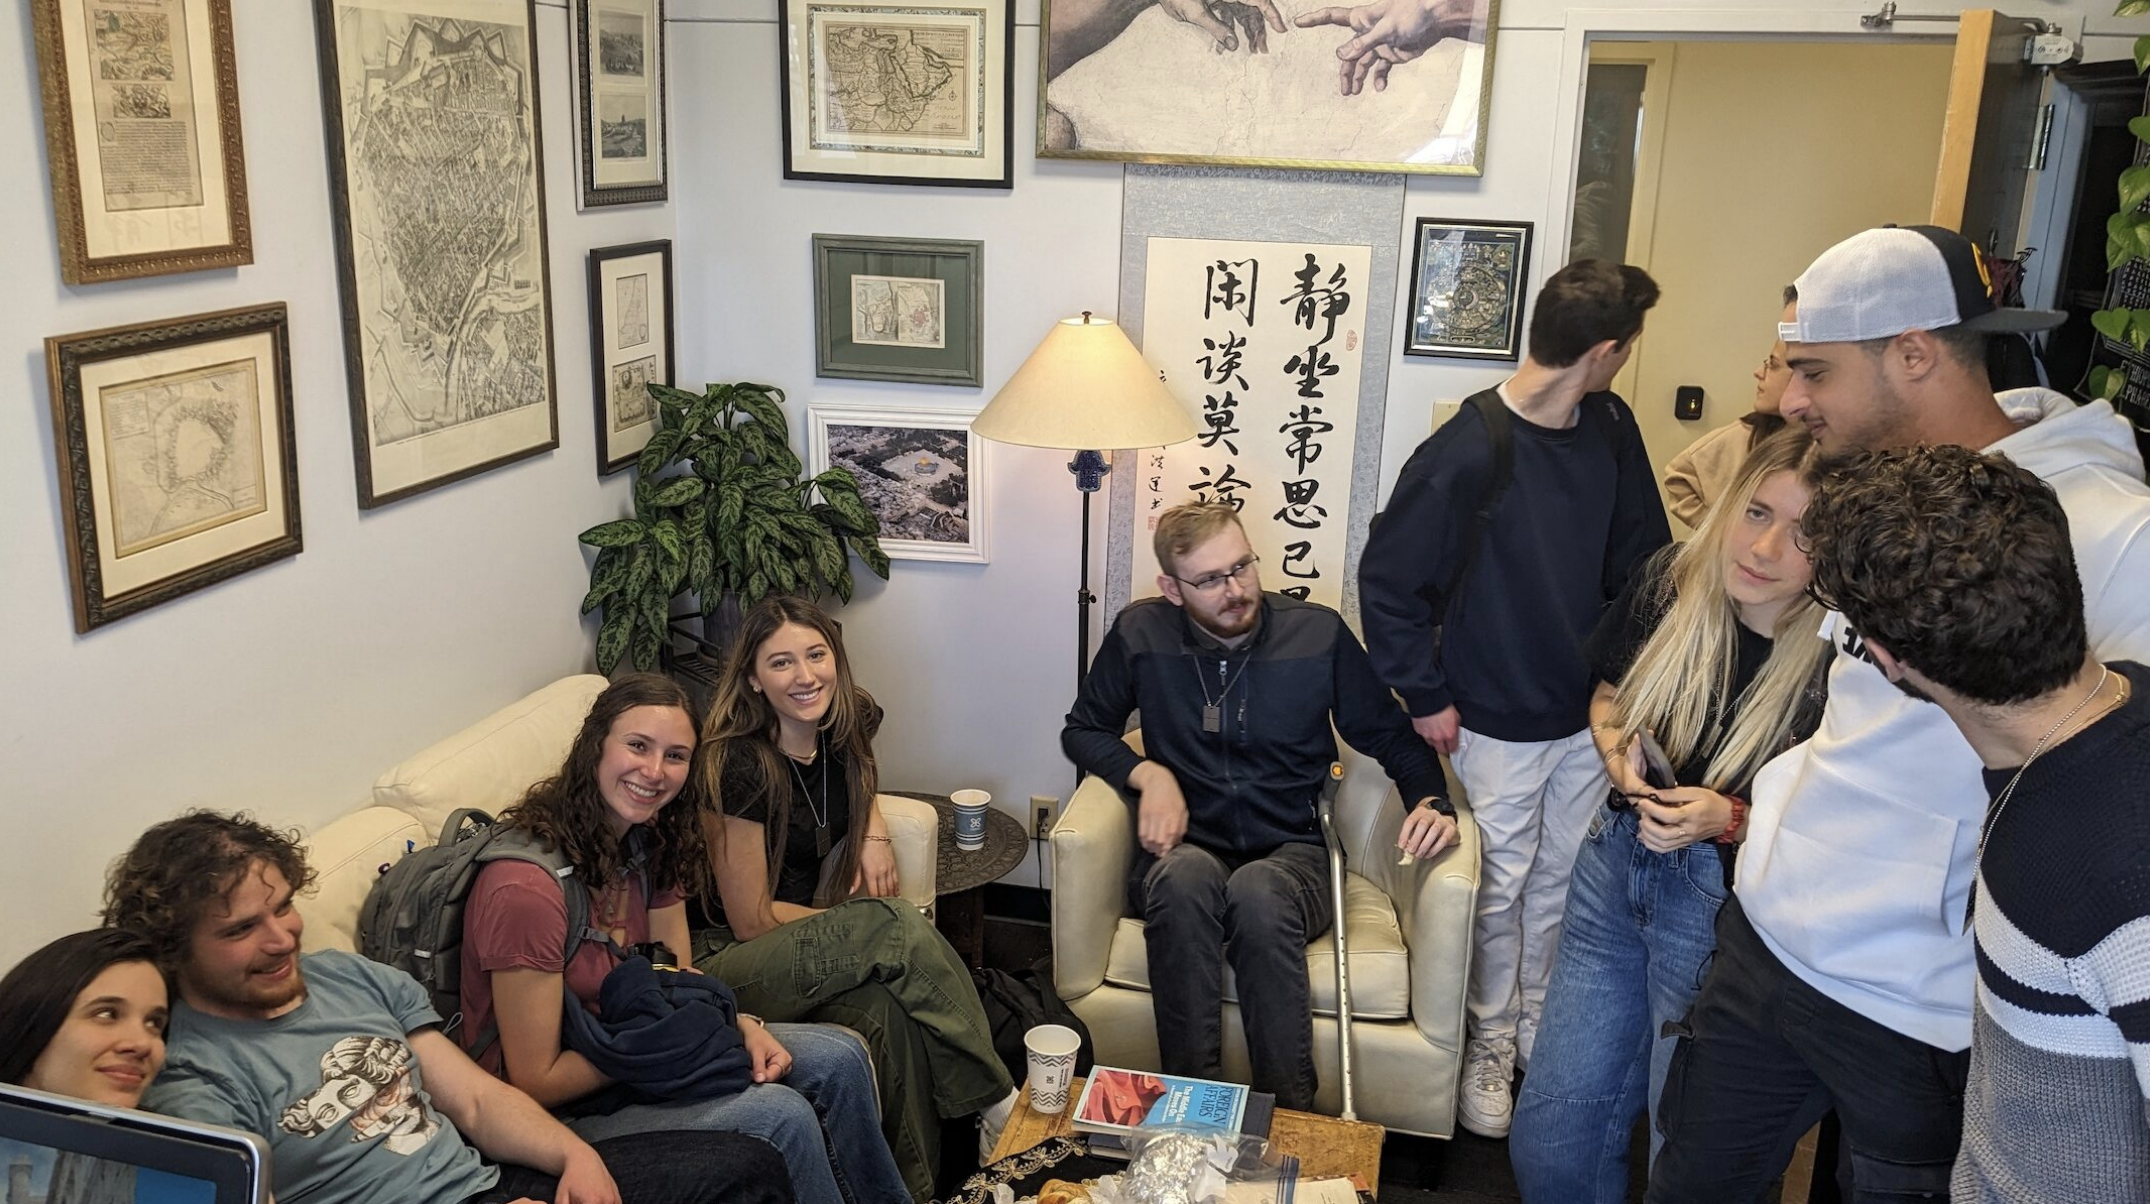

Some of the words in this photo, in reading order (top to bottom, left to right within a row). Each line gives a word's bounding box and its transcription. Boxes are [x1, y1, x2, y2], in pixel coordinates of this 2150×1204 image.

[1184, 1085, 1193, 1096] The
[1170, 1091, 1183, 1109] Moves
[1178, 1095, 1191, 1113] Middle
[1199, 1083, 1218, 1118] AFFAIRS
[1213, 1085, 1234, 1125] FOREIGN
[1168, 1108, 1178, 1117] On
